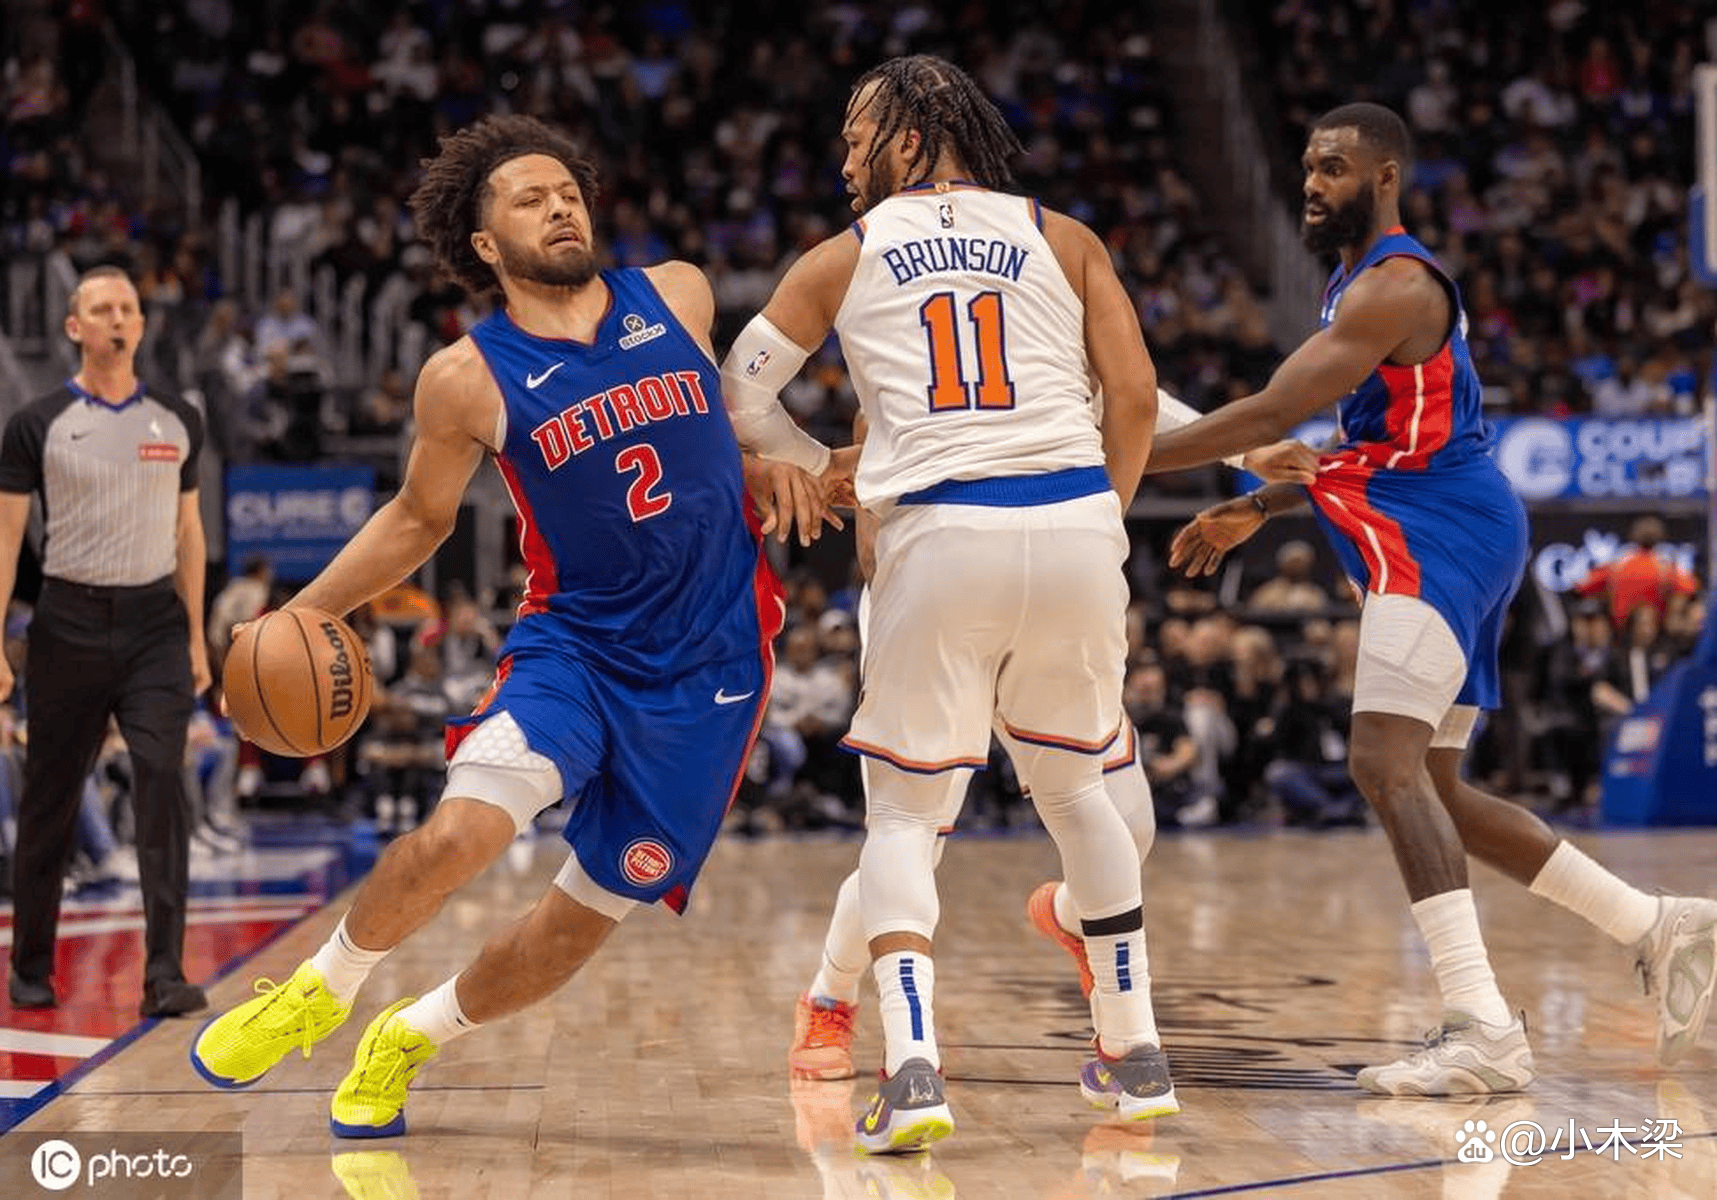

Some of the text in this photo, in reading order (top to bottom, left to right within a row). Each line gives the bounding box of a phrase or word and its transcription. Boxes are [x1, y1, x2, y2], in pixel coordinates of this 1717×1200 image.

[882, 237, 1029, 286] BRUNSON
[919, 291, 1016, 413] 11
[531, 371, 709, 471] DETROIT
[615, 443, 672, 522] 2
[319, 622, 353, 721] Wilson
